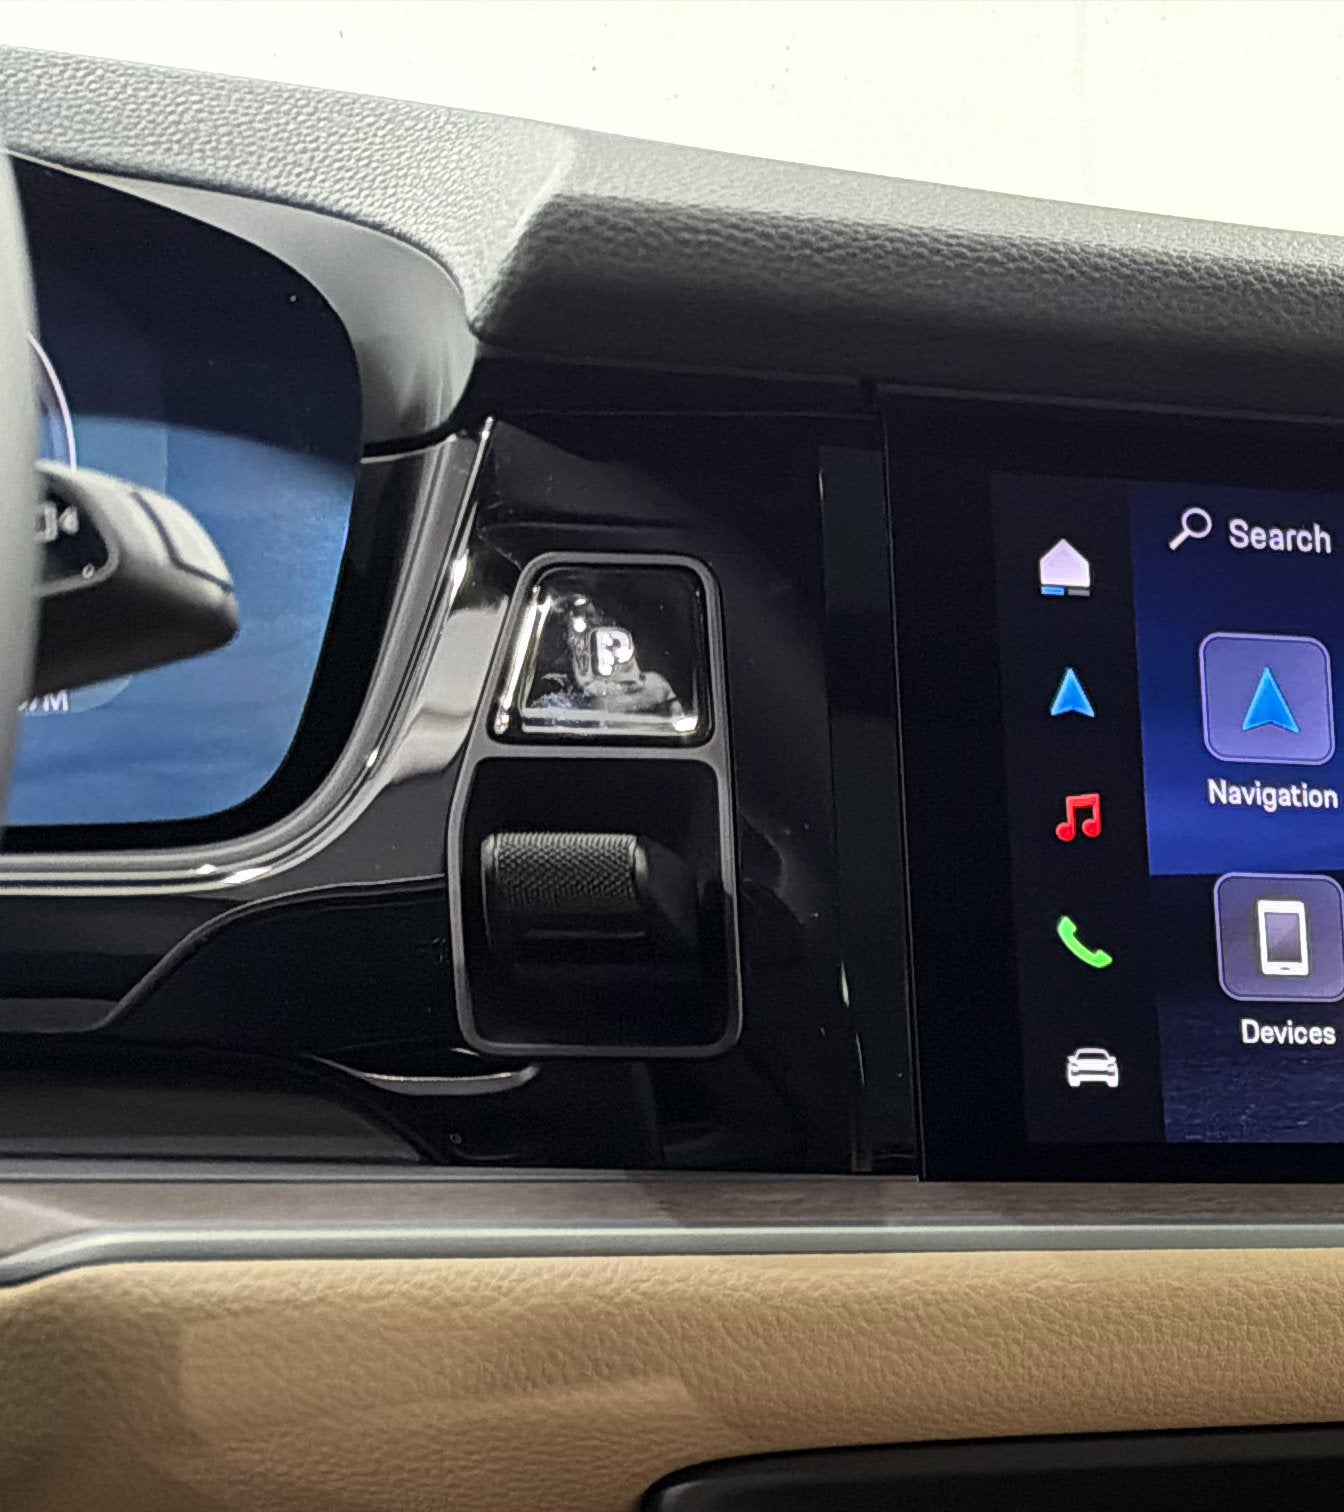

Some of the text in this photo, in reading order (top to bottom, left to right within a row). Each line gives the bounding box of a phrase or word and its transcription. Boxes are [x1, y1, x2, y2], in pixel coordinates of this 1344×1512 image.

[1229, 518, 1332, 554] Search
[1206, 778, 1339, 813] Navigation
[1241, 1018, 1337, 1046] Devices
